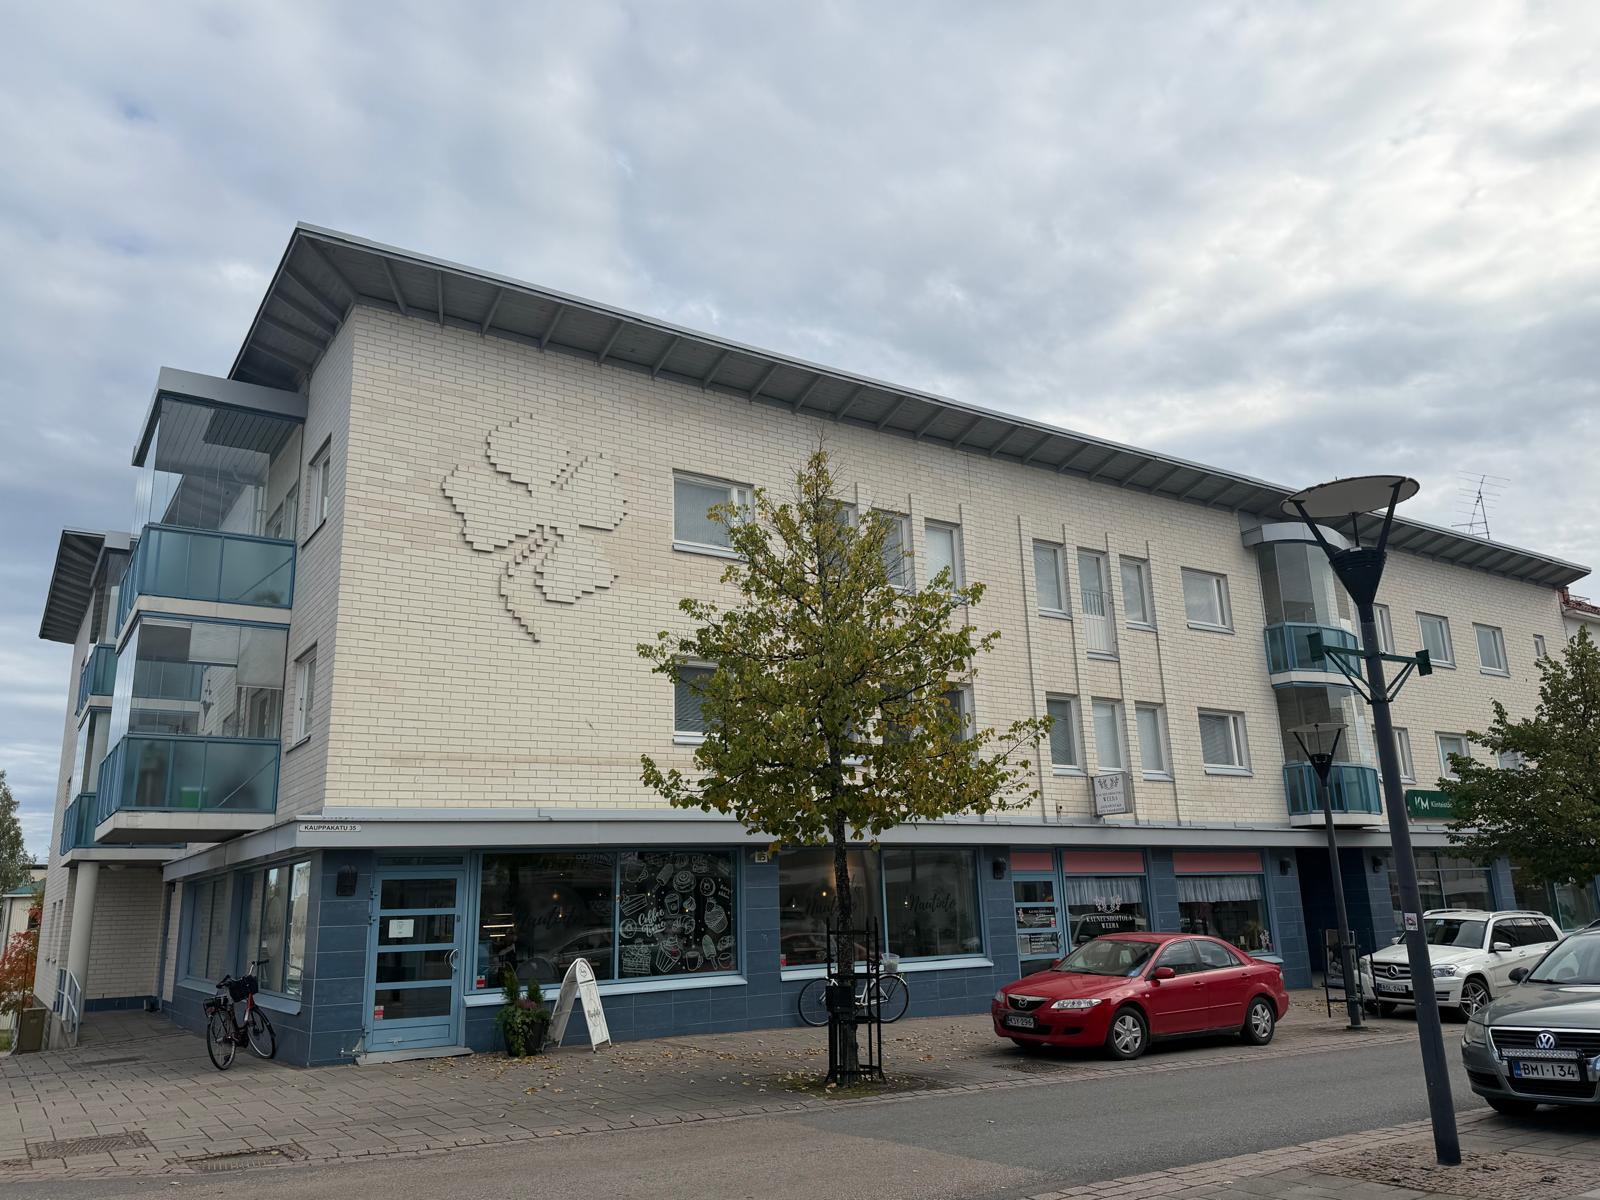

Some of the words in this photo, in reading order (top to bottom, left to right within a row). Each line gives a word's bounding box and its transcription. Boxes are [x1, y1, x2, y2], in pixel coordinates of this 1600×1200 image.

[638, 907, 665, 926] Coffee
[641, 921, 667, 937] Time
[1522, 1063, 1575, 1078] BMI-134
